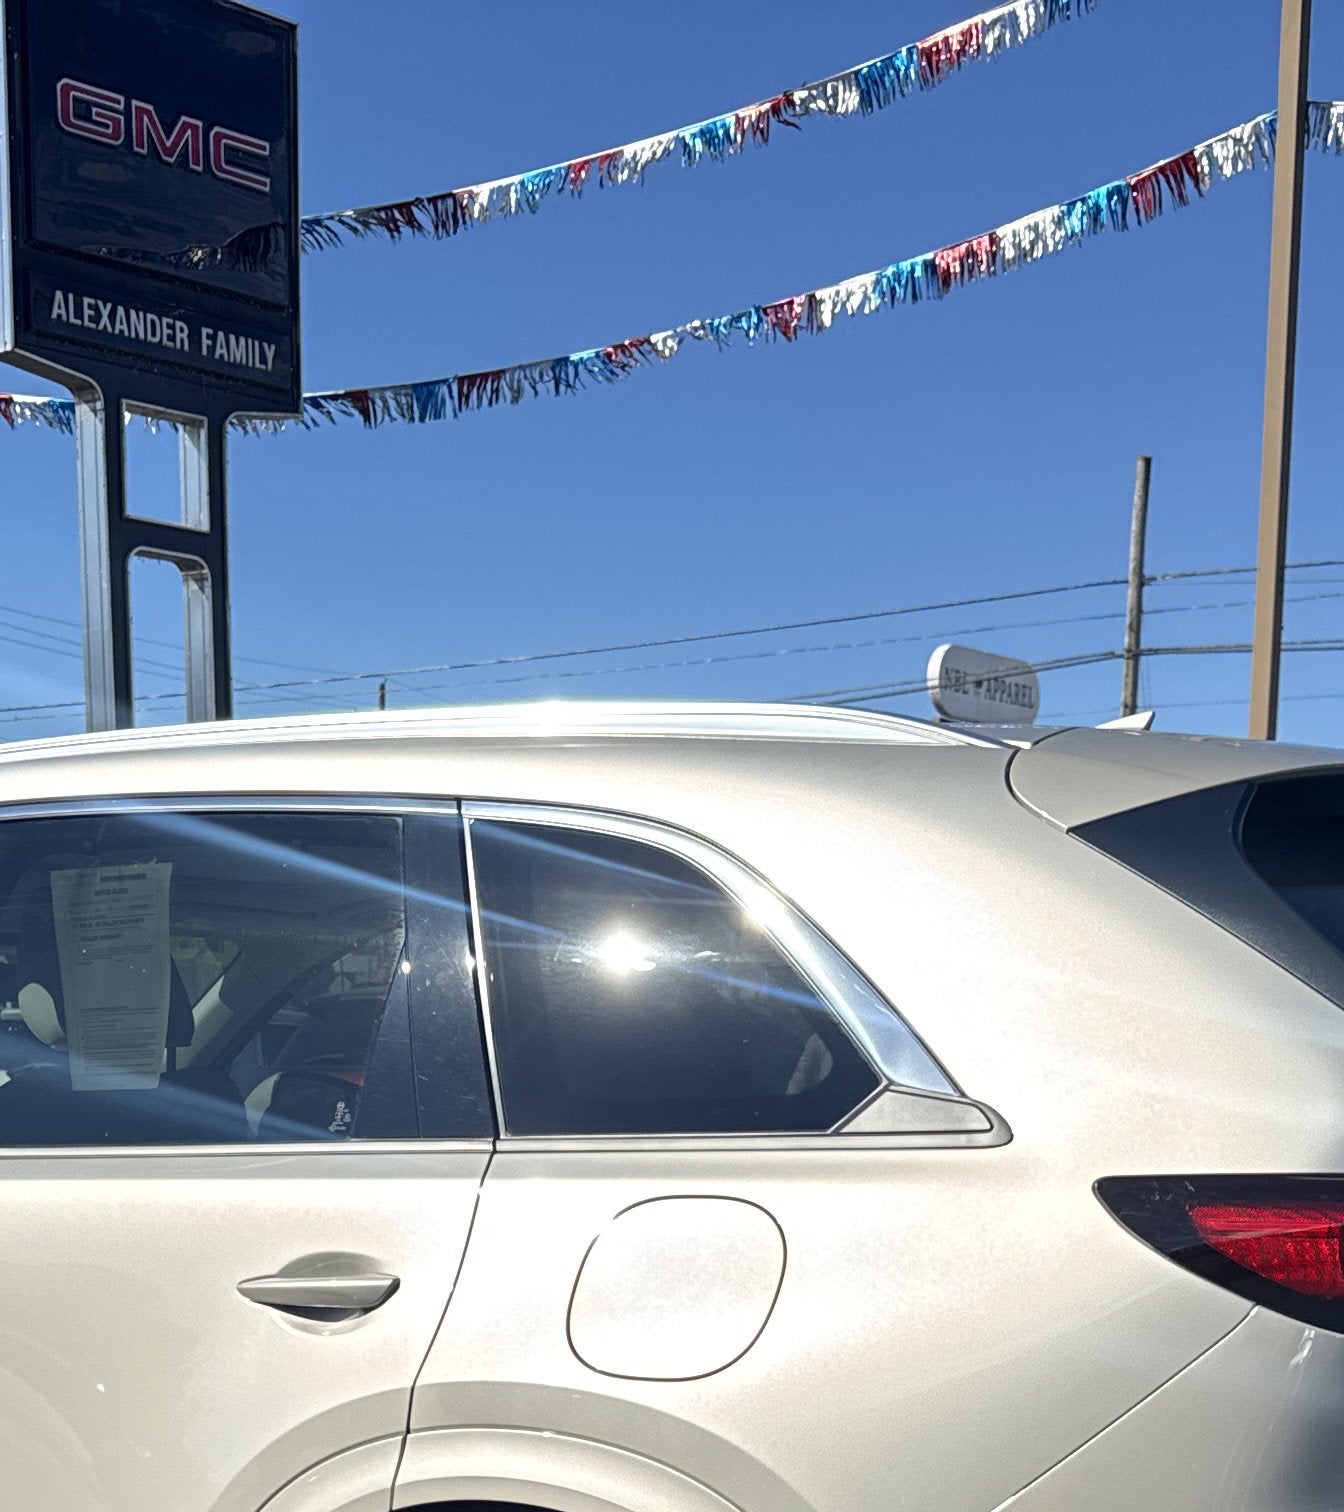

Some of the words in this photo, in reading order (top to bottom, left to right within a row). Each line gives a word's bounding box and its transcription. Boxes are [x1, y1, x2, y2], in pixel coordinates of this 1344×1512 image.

[56, 77, 271, 193] GMC
[50, 290, 190, 353] ALEXANDER
[200, 327, 277, 373] FAMILY
